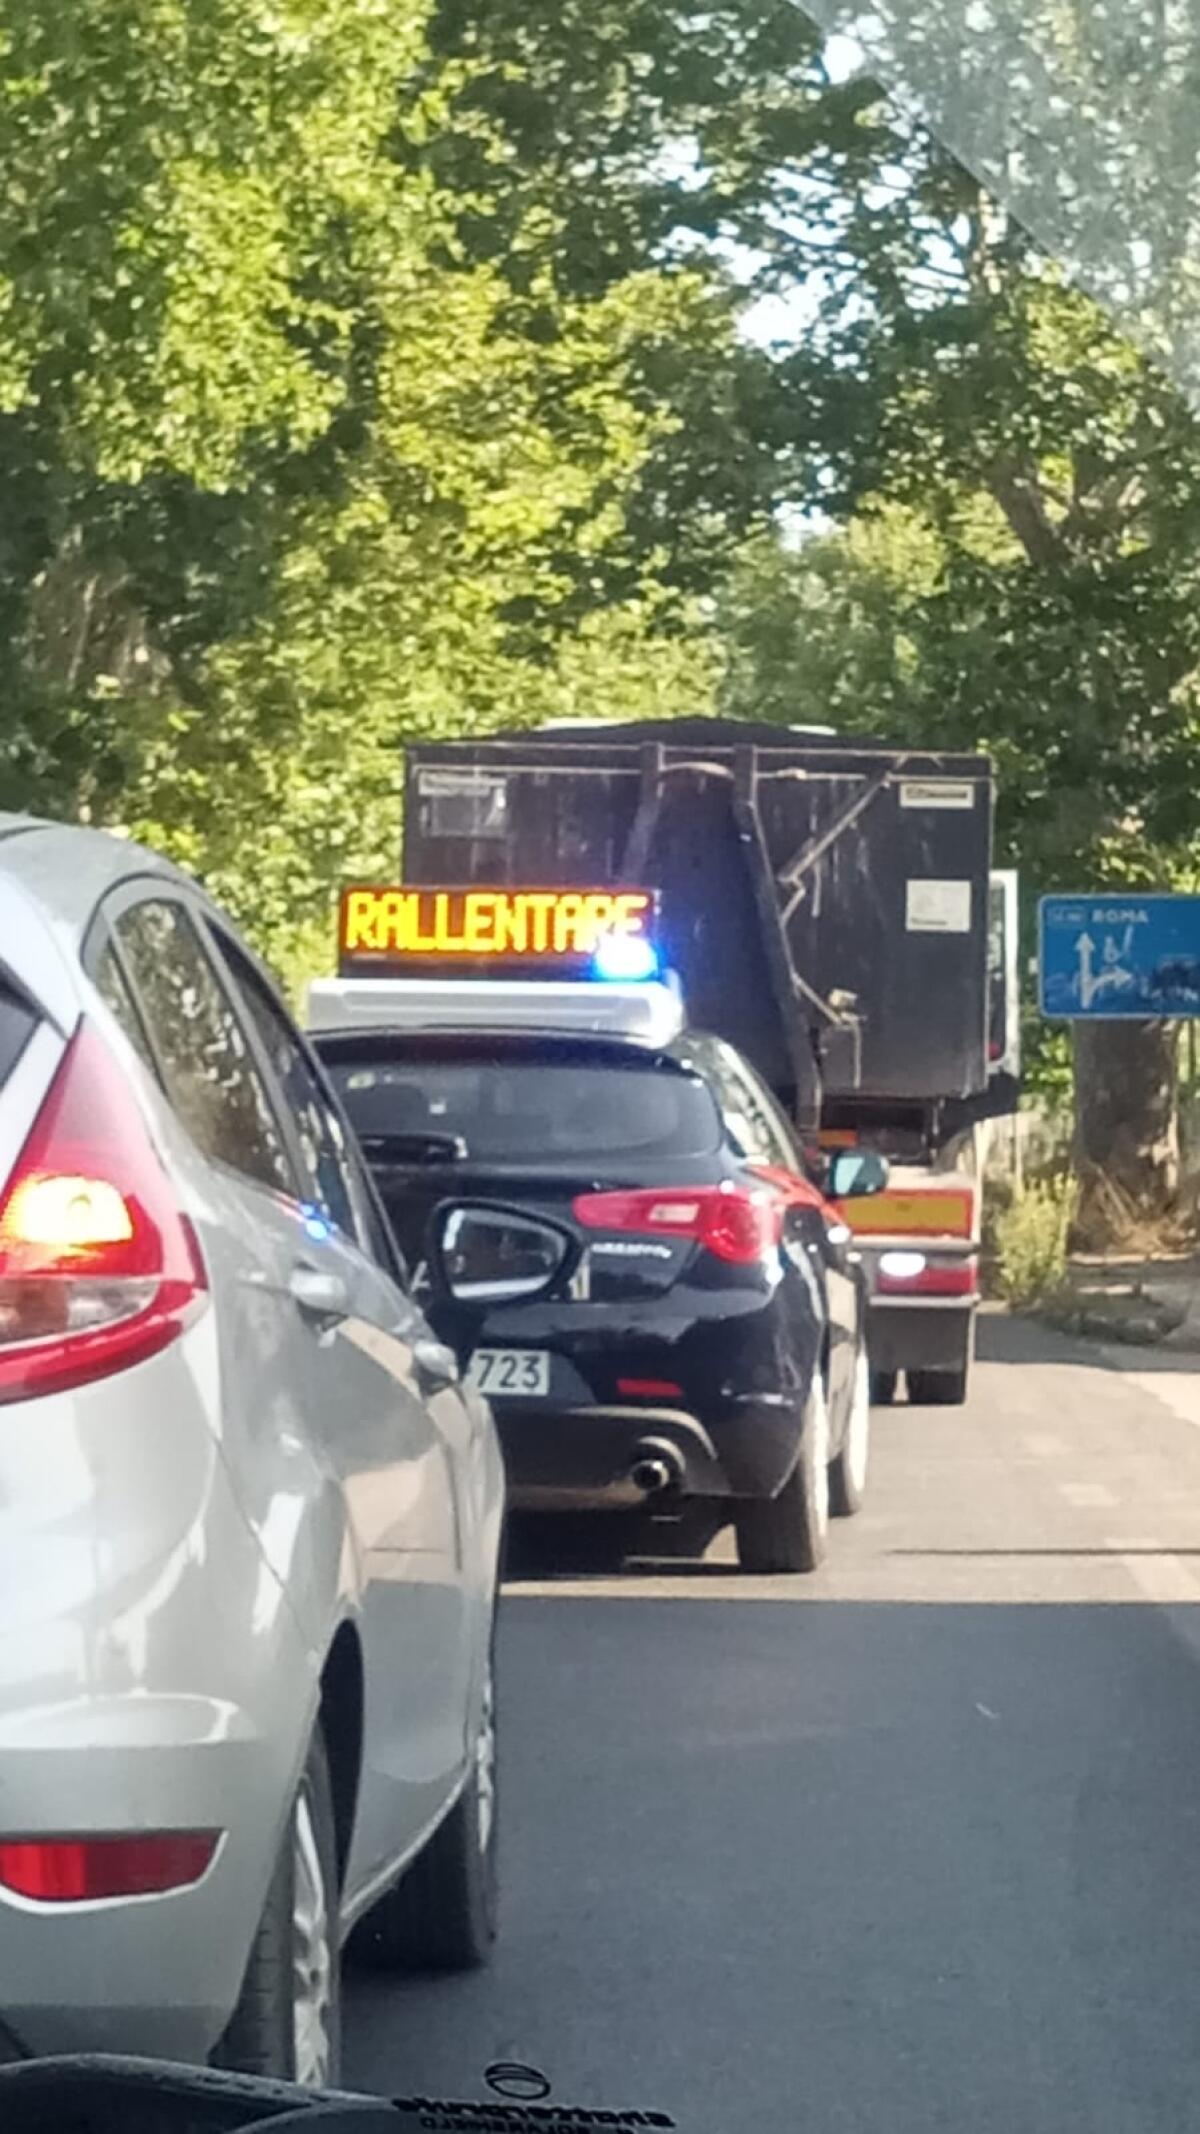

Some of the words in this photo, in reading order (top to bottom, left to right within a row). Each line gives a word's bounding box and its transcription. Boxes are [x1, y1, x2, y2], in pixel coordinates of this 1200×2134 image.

[346, 891, 648, 951] RALLENTARE
[1092, 908, 1148, 922] ROMA
[478, 1354, 541, 1389] 723
